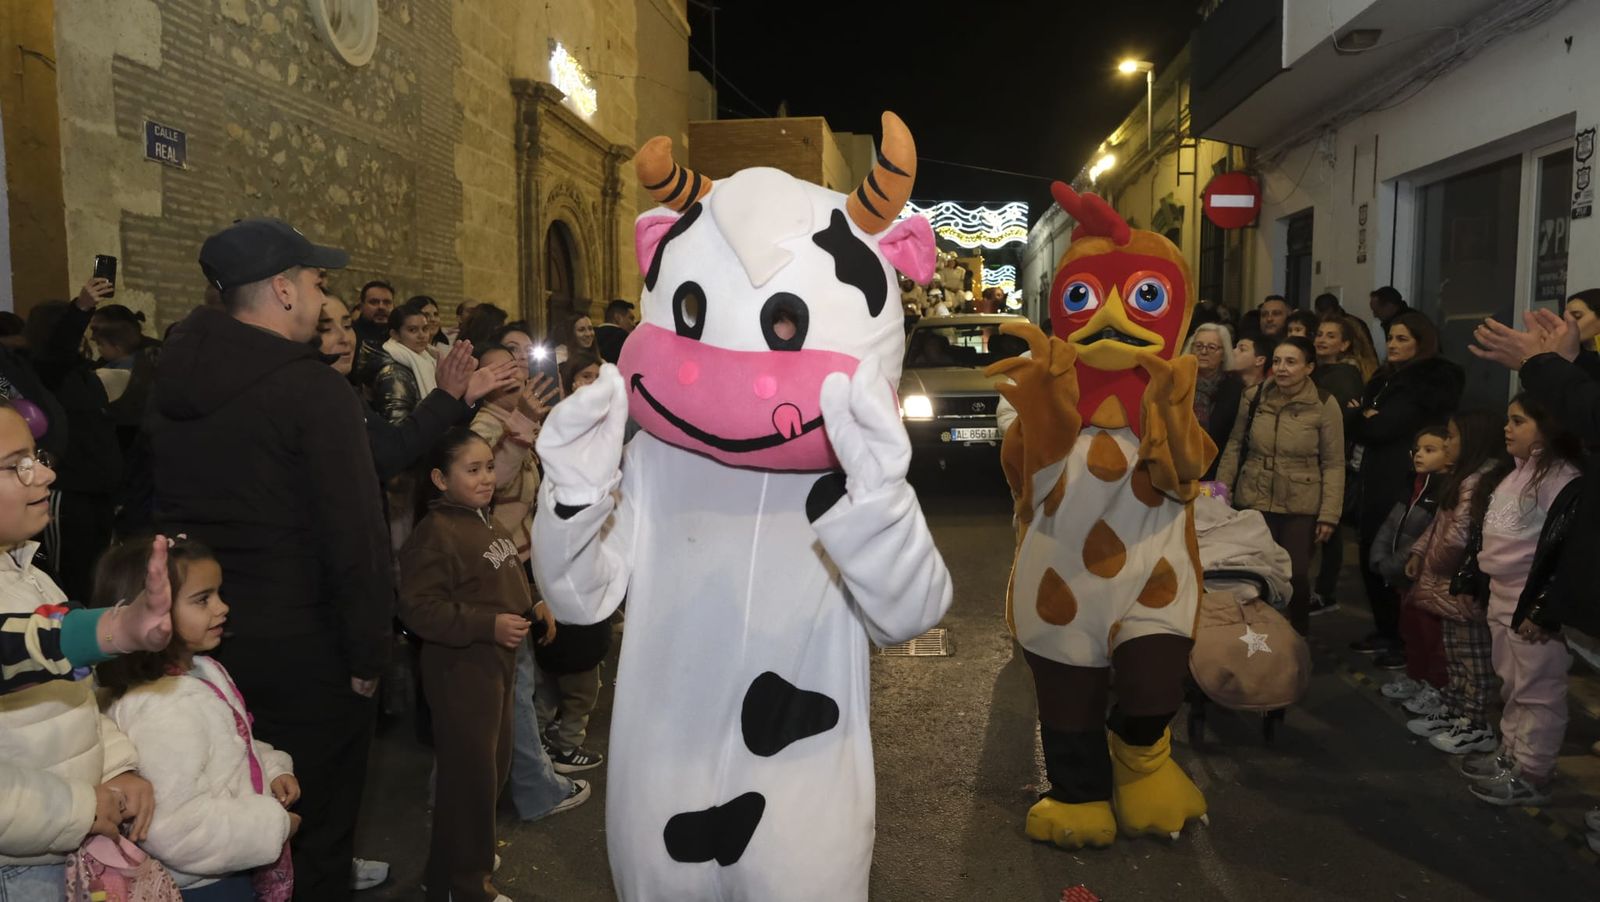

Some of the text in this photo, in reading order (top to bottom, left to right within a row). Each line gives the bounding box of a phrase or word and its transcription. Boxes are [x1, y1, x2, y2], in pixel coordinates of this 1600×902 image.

[154, 125, 179, 142] CALLE
[155, 142, 179, 163] REAL
[970, 429, 992, 439] 8561
